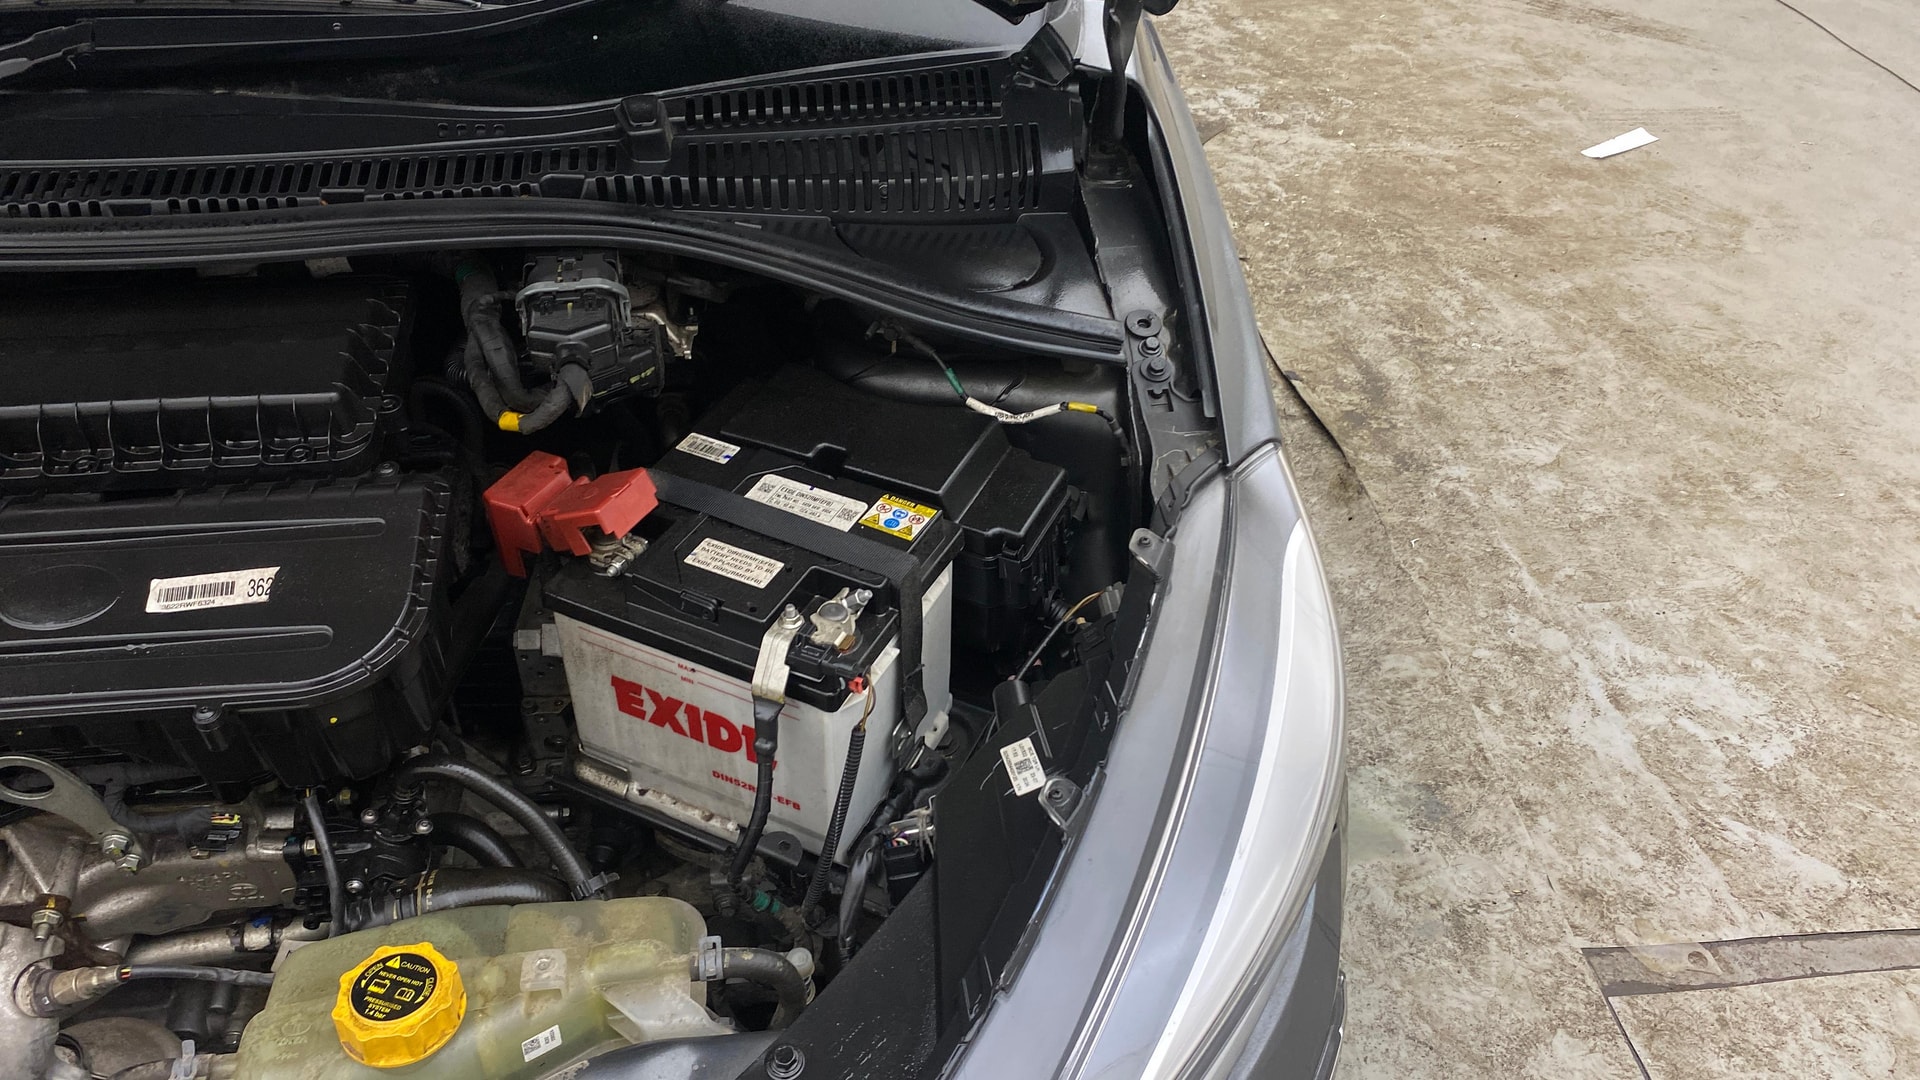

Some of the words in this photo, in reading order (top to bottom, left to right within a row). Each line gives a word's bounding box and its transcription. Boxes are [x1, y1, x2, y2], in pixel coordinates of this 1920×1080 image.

[890, 495, 916, 508] DANGER
[707, 541, 726, 551] EXIDE
[692, 557, 712, 568] EXIDE
[701, 546, 729, 559] BATTERY
[730, 555, 753, 567] NEEDS
[754, 561, 763, 570] TO
[764, 566, 775, 574] BE
[710, 556, 743, 570] REPLACED
[744, 566, 755, 574] BY
[680, 675, 694, 685] MIN
[364, 962, 384, 977] OPEN
[400, 961, 431, 974] CAUTION
[378, 970, 397, 980] NEVER
[396, 973, 411, 983] OPEN
[411, 978, 424, 987] HOT
[364, 1008, 375, 1017] 1.4
[374, 1010, 386, 1019] bar
[367, 1003, 391, 1013] SYSTEM
